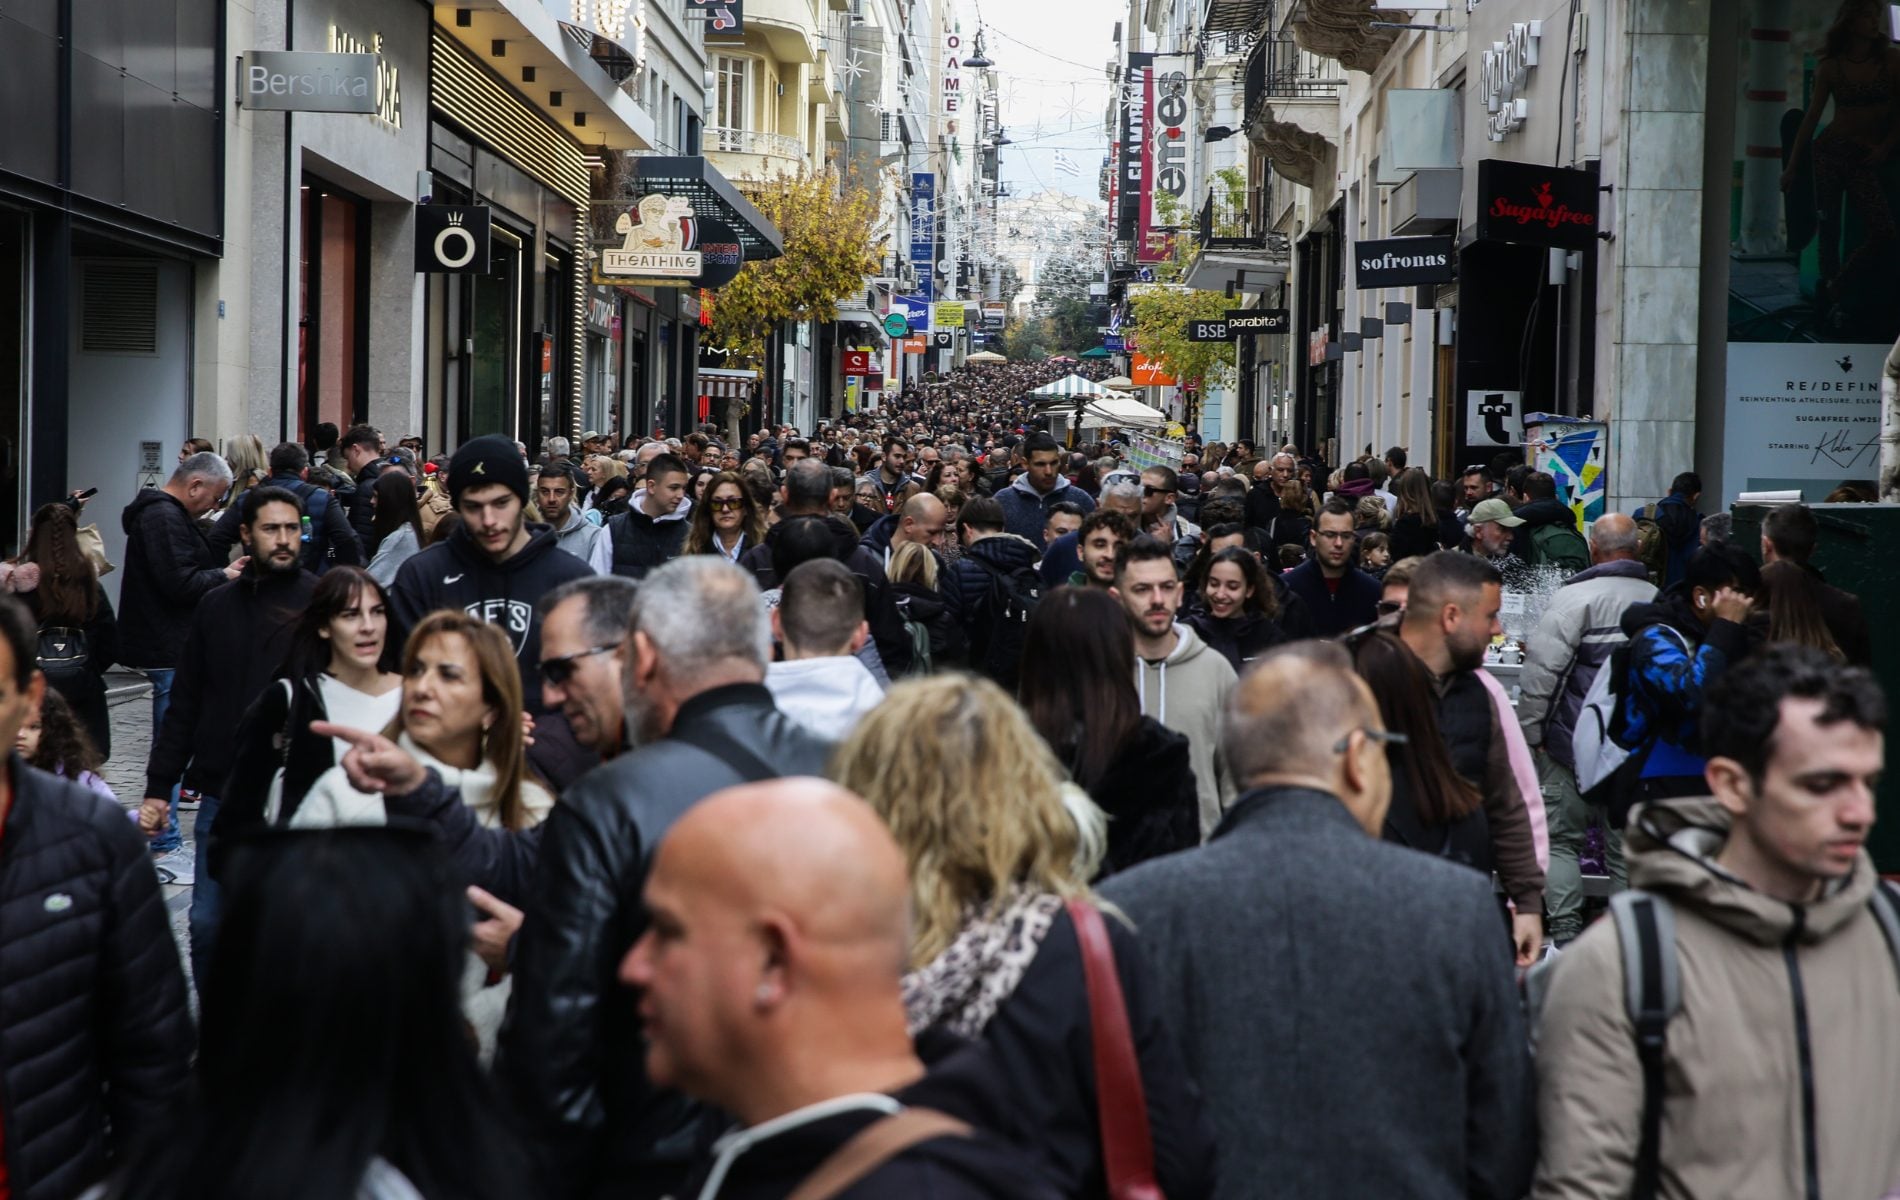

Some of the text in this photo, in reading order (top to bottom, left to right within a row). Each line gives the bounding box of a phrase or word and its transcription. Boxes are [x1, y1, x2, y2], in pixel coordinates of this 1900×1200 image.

[249, 65, 368, 97] Bershka
[1489, 196, 1594, 229] Sugarfree
[702, 243, 738, 253] INTER
[702, 253, 738, 265] SPORT
[1361, 253, 1447, 271] sofronas
[1228, 316, 1277, 328] parabita
[1197, 324, 1227, 338] BSB
[1795, 415, 1849, 423] SUGARFREE
